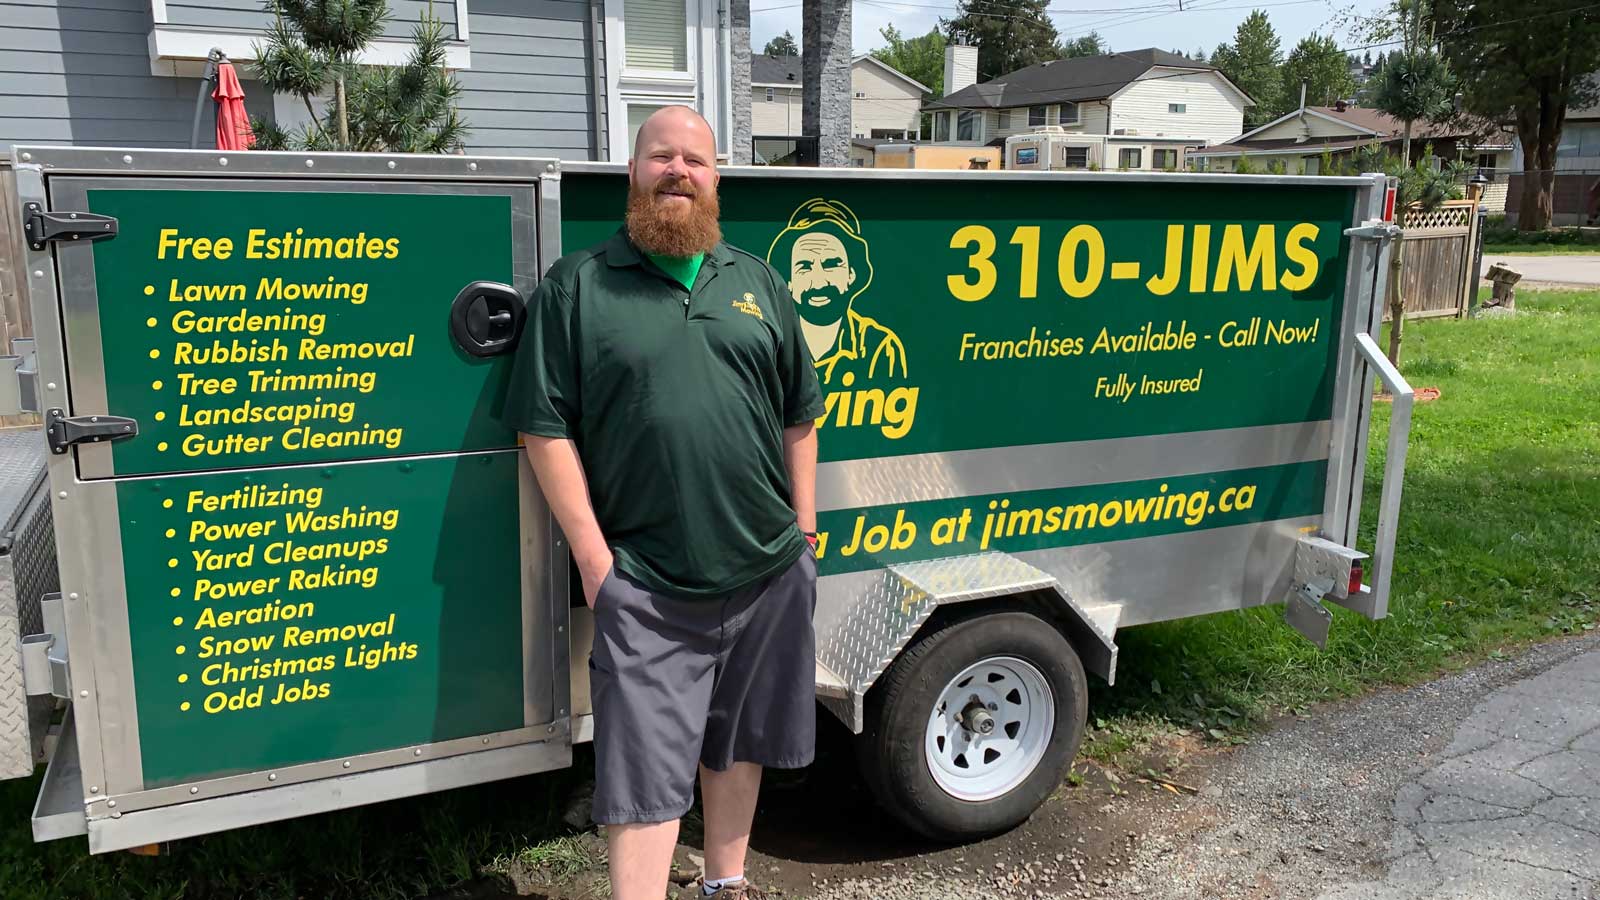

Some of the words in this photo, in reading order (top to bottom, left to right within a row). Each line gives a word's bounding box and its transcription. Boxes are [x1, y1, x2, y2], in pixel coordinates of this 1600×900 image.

[158, 229, 233, 259] Free
[247, 229, 399, 259] Estimates
[948, 223, 1319, 301] 310-JIMS
[170, 280, 246, 301] Lawn
[256, 277, 368, 304] Mowing
[172, 308, 325, 335] Gardening
[175, 339, 287, 364] Rubbish
[299, 336, 414, 359] Removal
[960, 329, 1083, 360] Franchises
[1090, 320, 1197, 353] Available
[1218, 317, 1261, 348] Call
[1264, 318, 1320, 345] Now!
[178, 374, 237, 395] Tree
[249, 367, 375, 392] Trimming
[1095, 373, 1136, 402] Fully
[1140, 368, 1203, 395] Insured
[180, 397, 354, 426] Landscaping
[183, 434, 272, 456] Gutter
[282, 424, 402, 449] Cleaning
[187, 484, 322, 512] Fertilizing
[190, 521, 276, 542] Power
[286, 506, 398, 533] Washing
[841, 510, 916, 556] Job
[931, 509, 971, 545] at
[980, 484, 1256, 550] jimsmowing.ca
[193, 545, 254, 570] Yard
[264, 539, 388, 564] Cleanups
[194, 577, 281, 601] Power
[289, 565, 377, 590] Raking
[195, 600, 313, 629] Aeration
[198, 635, 275, 659] Snow
[284, 614, 394, 649] Removal
[202, 656, 335, 685] Christmas
[345, 642, 416, 669] Lights
[203, 685, 264, 714] Odd
[272, 680, 329, 704] Jobs
